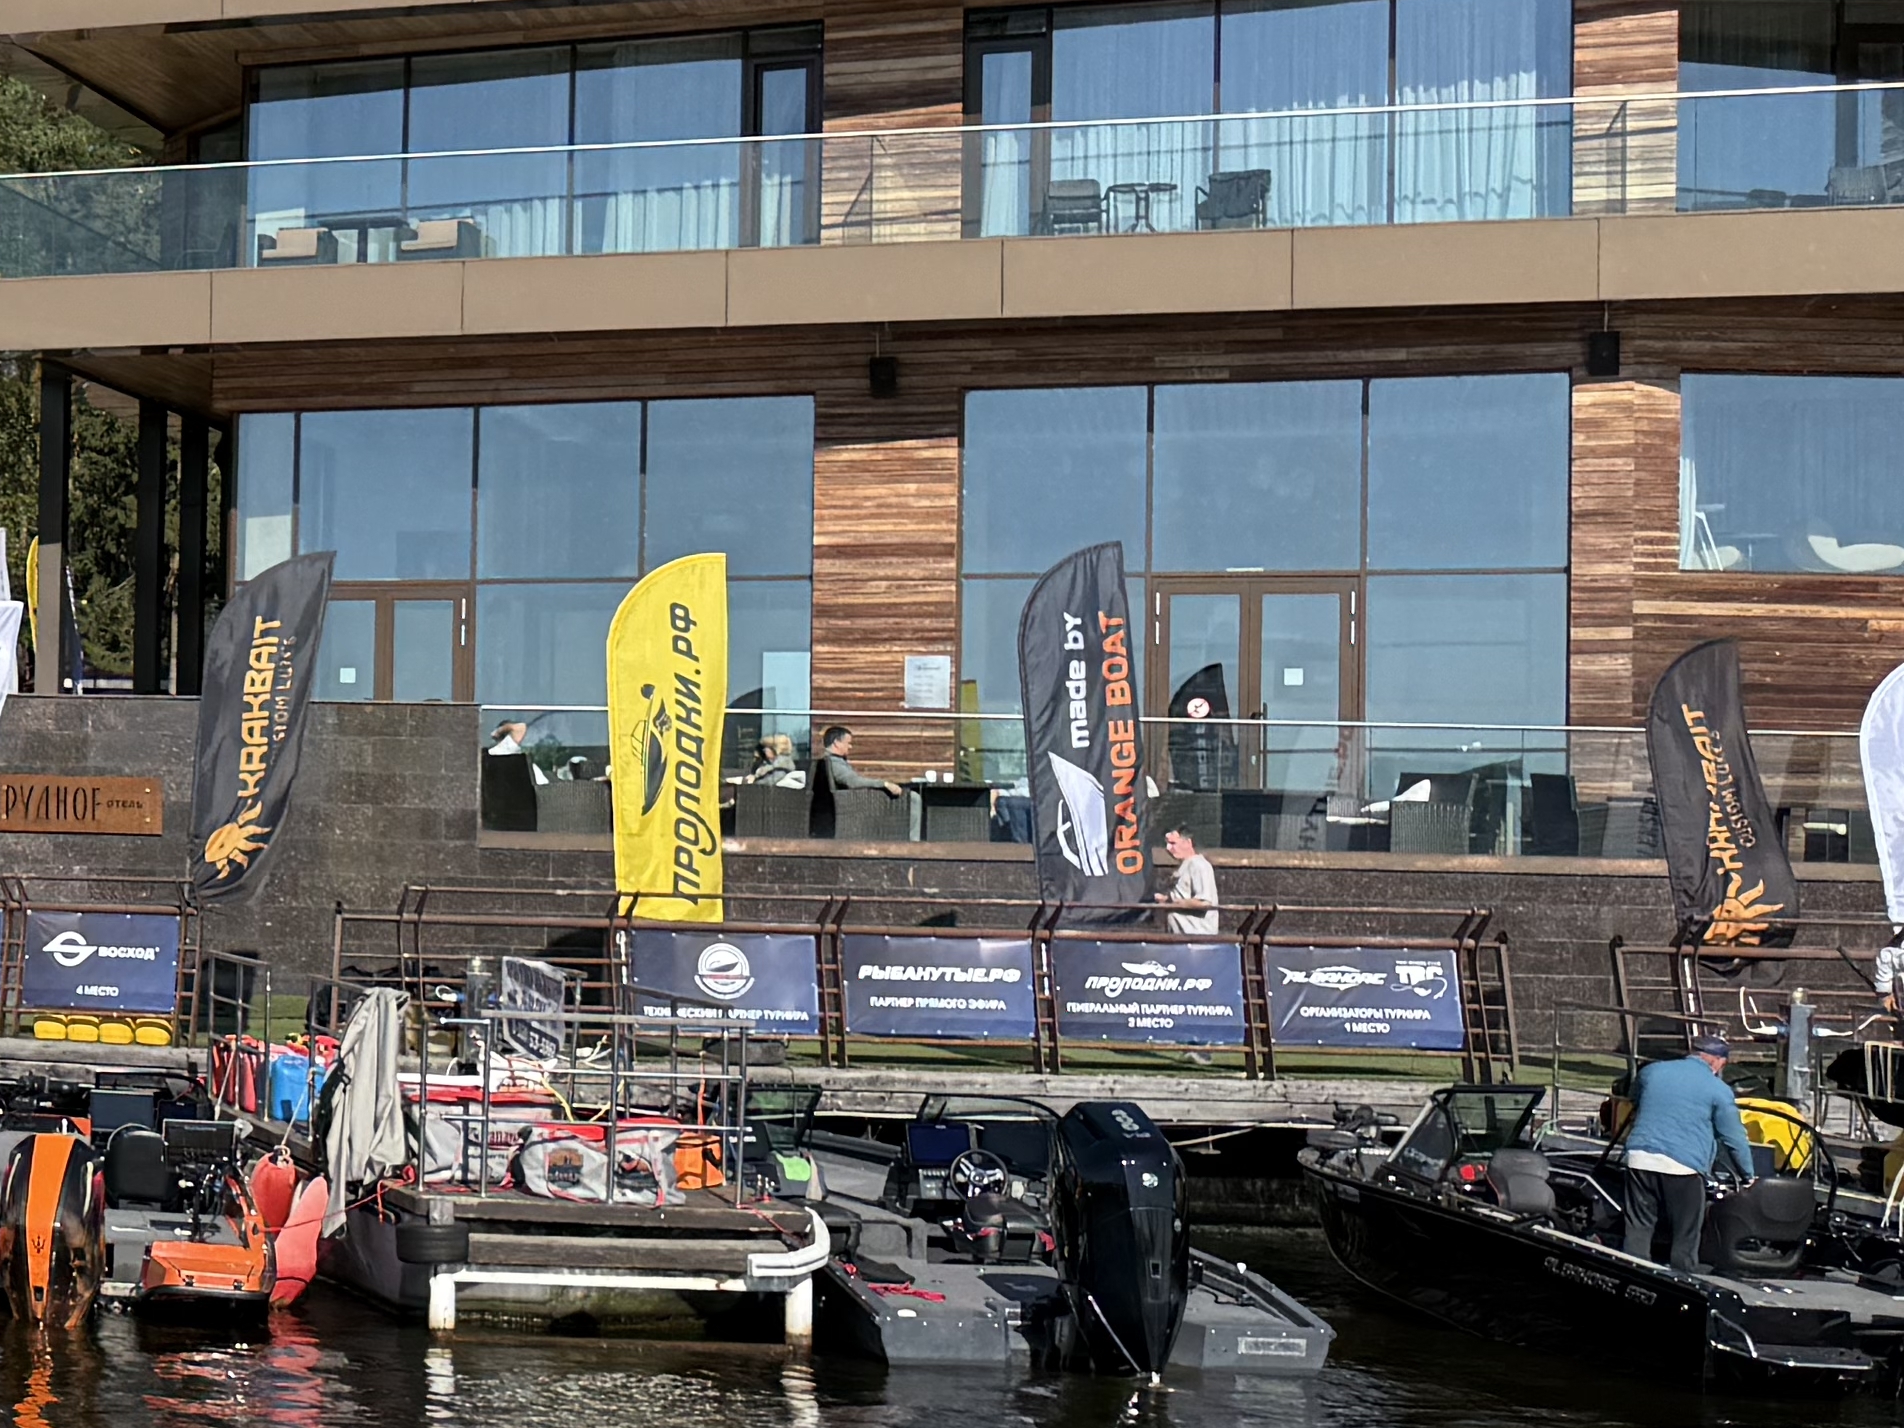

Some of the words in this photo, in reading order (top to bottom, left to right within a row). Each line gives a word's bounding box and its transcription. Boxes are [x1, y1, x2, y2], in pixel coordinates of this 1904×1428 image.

[1097, 610, 1133, 707] BOAT
[237, 615, 282, 798] KRAKBAIT
[1065, 659, 1091, 750] made
[669, 601, 717, 906] ПРОЛОДКИ.РФ
[1108, 719, 1145, 876] ORANGE
[97, 947, 156, 961] ВОСХОД
[858, 964, 1022, 984] РЫБАНУТЫЕ.РФ
[76, 985, 83, 996] 4
[1136, 1017, 1175, 1030] МЕСТО
[1352, 1021, 1391, 1034] МЕСТО
